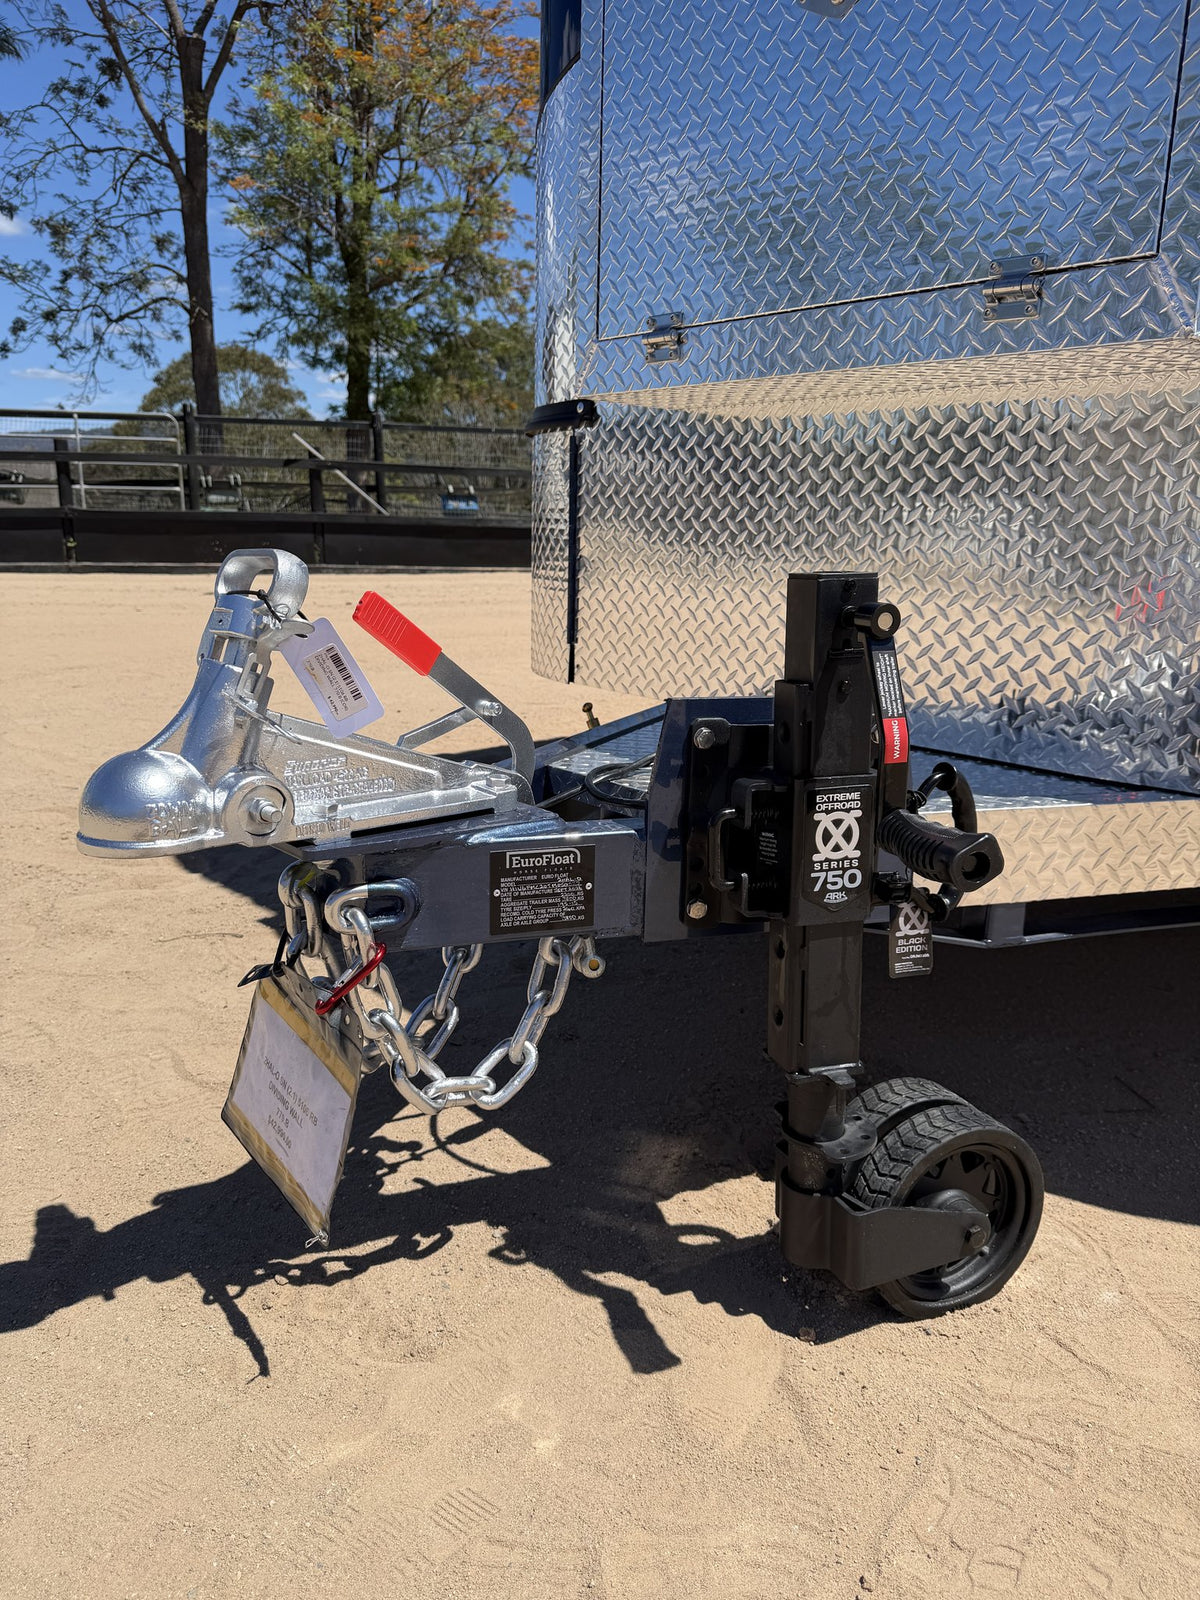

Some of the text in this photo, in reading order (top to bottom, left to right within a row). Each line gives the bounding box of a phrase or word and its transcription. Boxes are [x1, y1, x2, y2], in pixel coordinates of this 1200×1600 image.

[892, 720, 900, 759] WARNING
[816, 792, 860, 803] EXTREME
[816, 801, 860, 811] OFFROAD
[512, 853, 574, 868] EuroFloat
[814, 860, 858, 870] SERIES
[811, 869, 862, 892] 750
[825, 891, 846, 900] ARK
[898, 937, 926, 946] BLACK
[896, 944, 928, 953] EDITION
[269, 1081, 303, 1128] DIVIDING WALL
